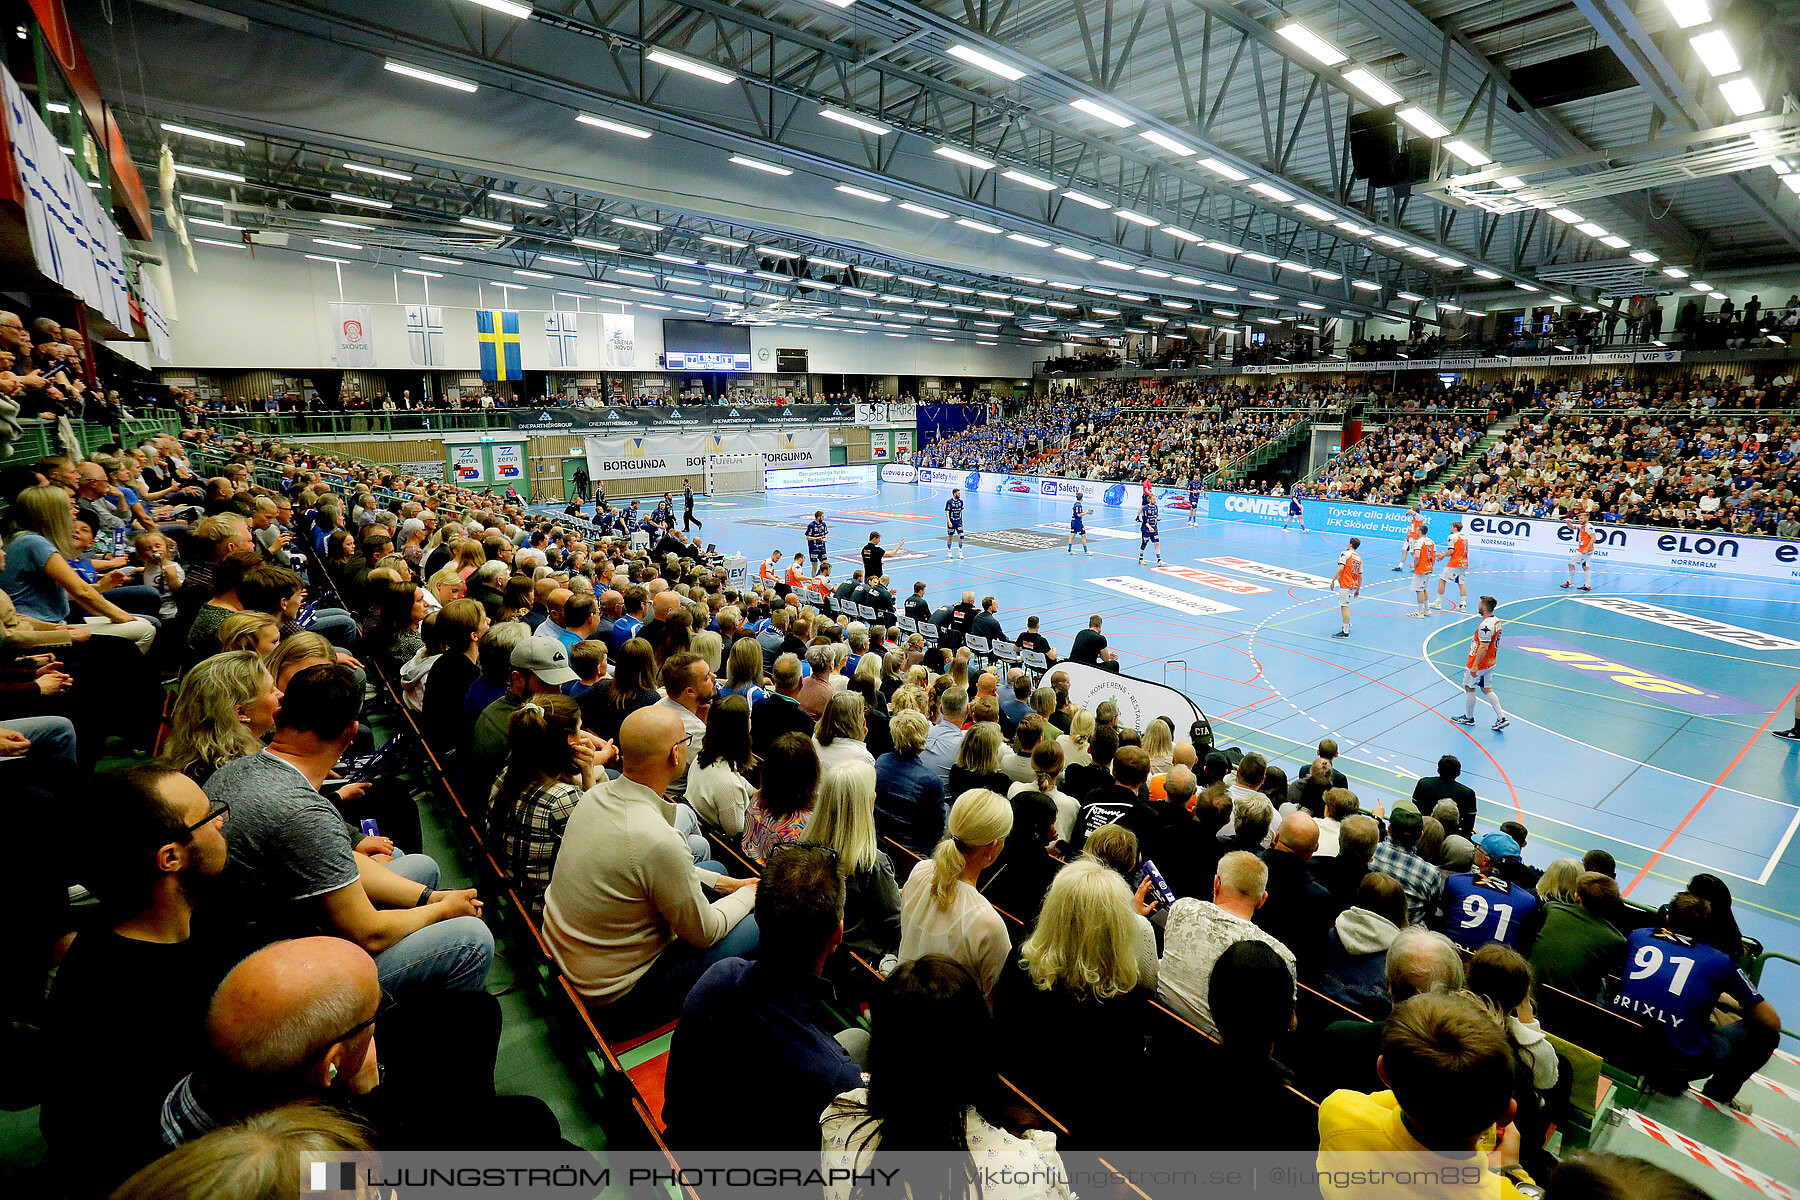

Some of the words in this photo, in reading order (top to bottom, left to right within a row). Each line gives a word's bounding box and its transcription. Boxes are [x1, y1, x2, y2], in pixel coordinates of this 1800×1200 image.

[1642, 353, 1659, 361] VIP
[767, 452, 813, 462] ORGUNDA
[603, 459, 666, 471] BORGUNDA
[932, 471, 948, 481] Safety
[1058, 482, 1079, 494] Safety
[1080, 485, 1094, 494] Reel
[1224, 495, 1303, 518] CONTEC
[1328, 507, 1362, 517] Trycker
[1364, 511, 1383, 520] alla
[1326, 518, 1343, 527] IFK
[1344, 520, 1379, 531] Skövde
[1671, 559, 1717, 568] NORRMALM
[1089, 681, 1128, 696] KONFERENS
[1129, 694, 1141, 732] RESTAUR
[1194, 726, 1210, 736] CIA
[1460, 894, 1513, 942] 91
[1629, 945, 1696, 997] 91
[1613, 994, 1684, 1028] BRIXLY
